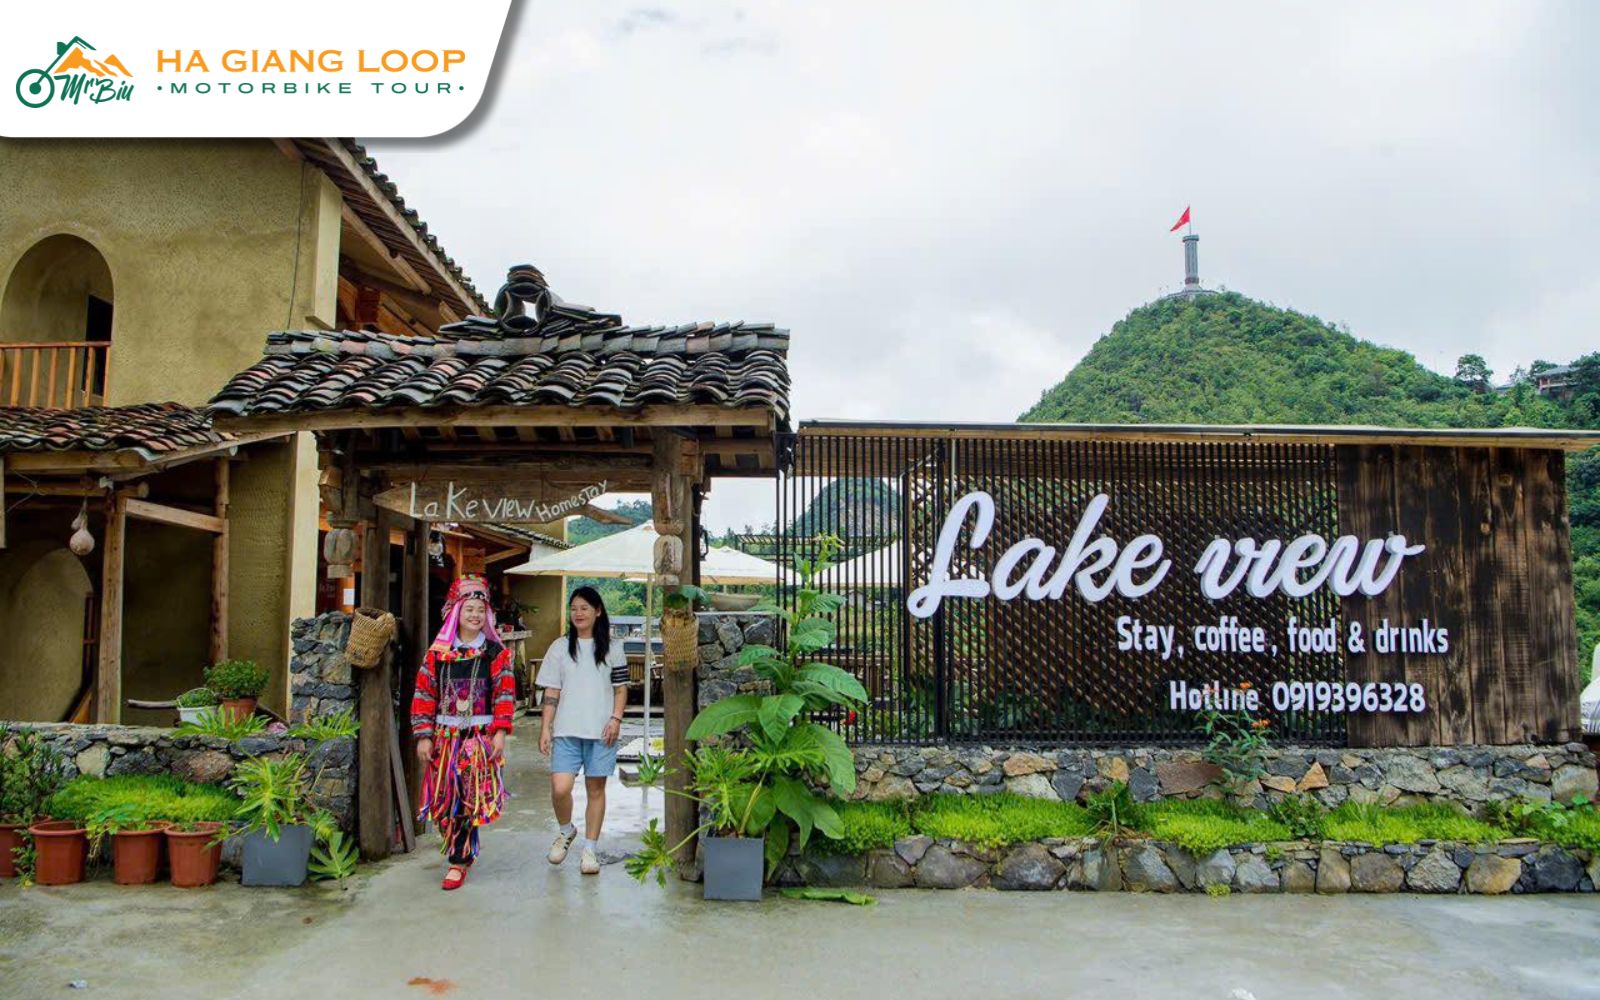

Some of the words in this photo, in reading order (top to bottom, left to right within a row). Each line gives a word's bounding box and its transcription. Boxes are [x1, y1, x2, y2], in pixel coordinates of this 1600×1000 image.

[906, 490, 1172, 618] Lake
[1193, 533, 1425, 600] view
[1287, 616, 1336, 653] food
[1349, 621, 1366, 653] &
[1376, 618, 1449, 653] drinks
[1170, 680, 1259, 711] Hotline
[1272, 681, 1426, 712] 0919396328
